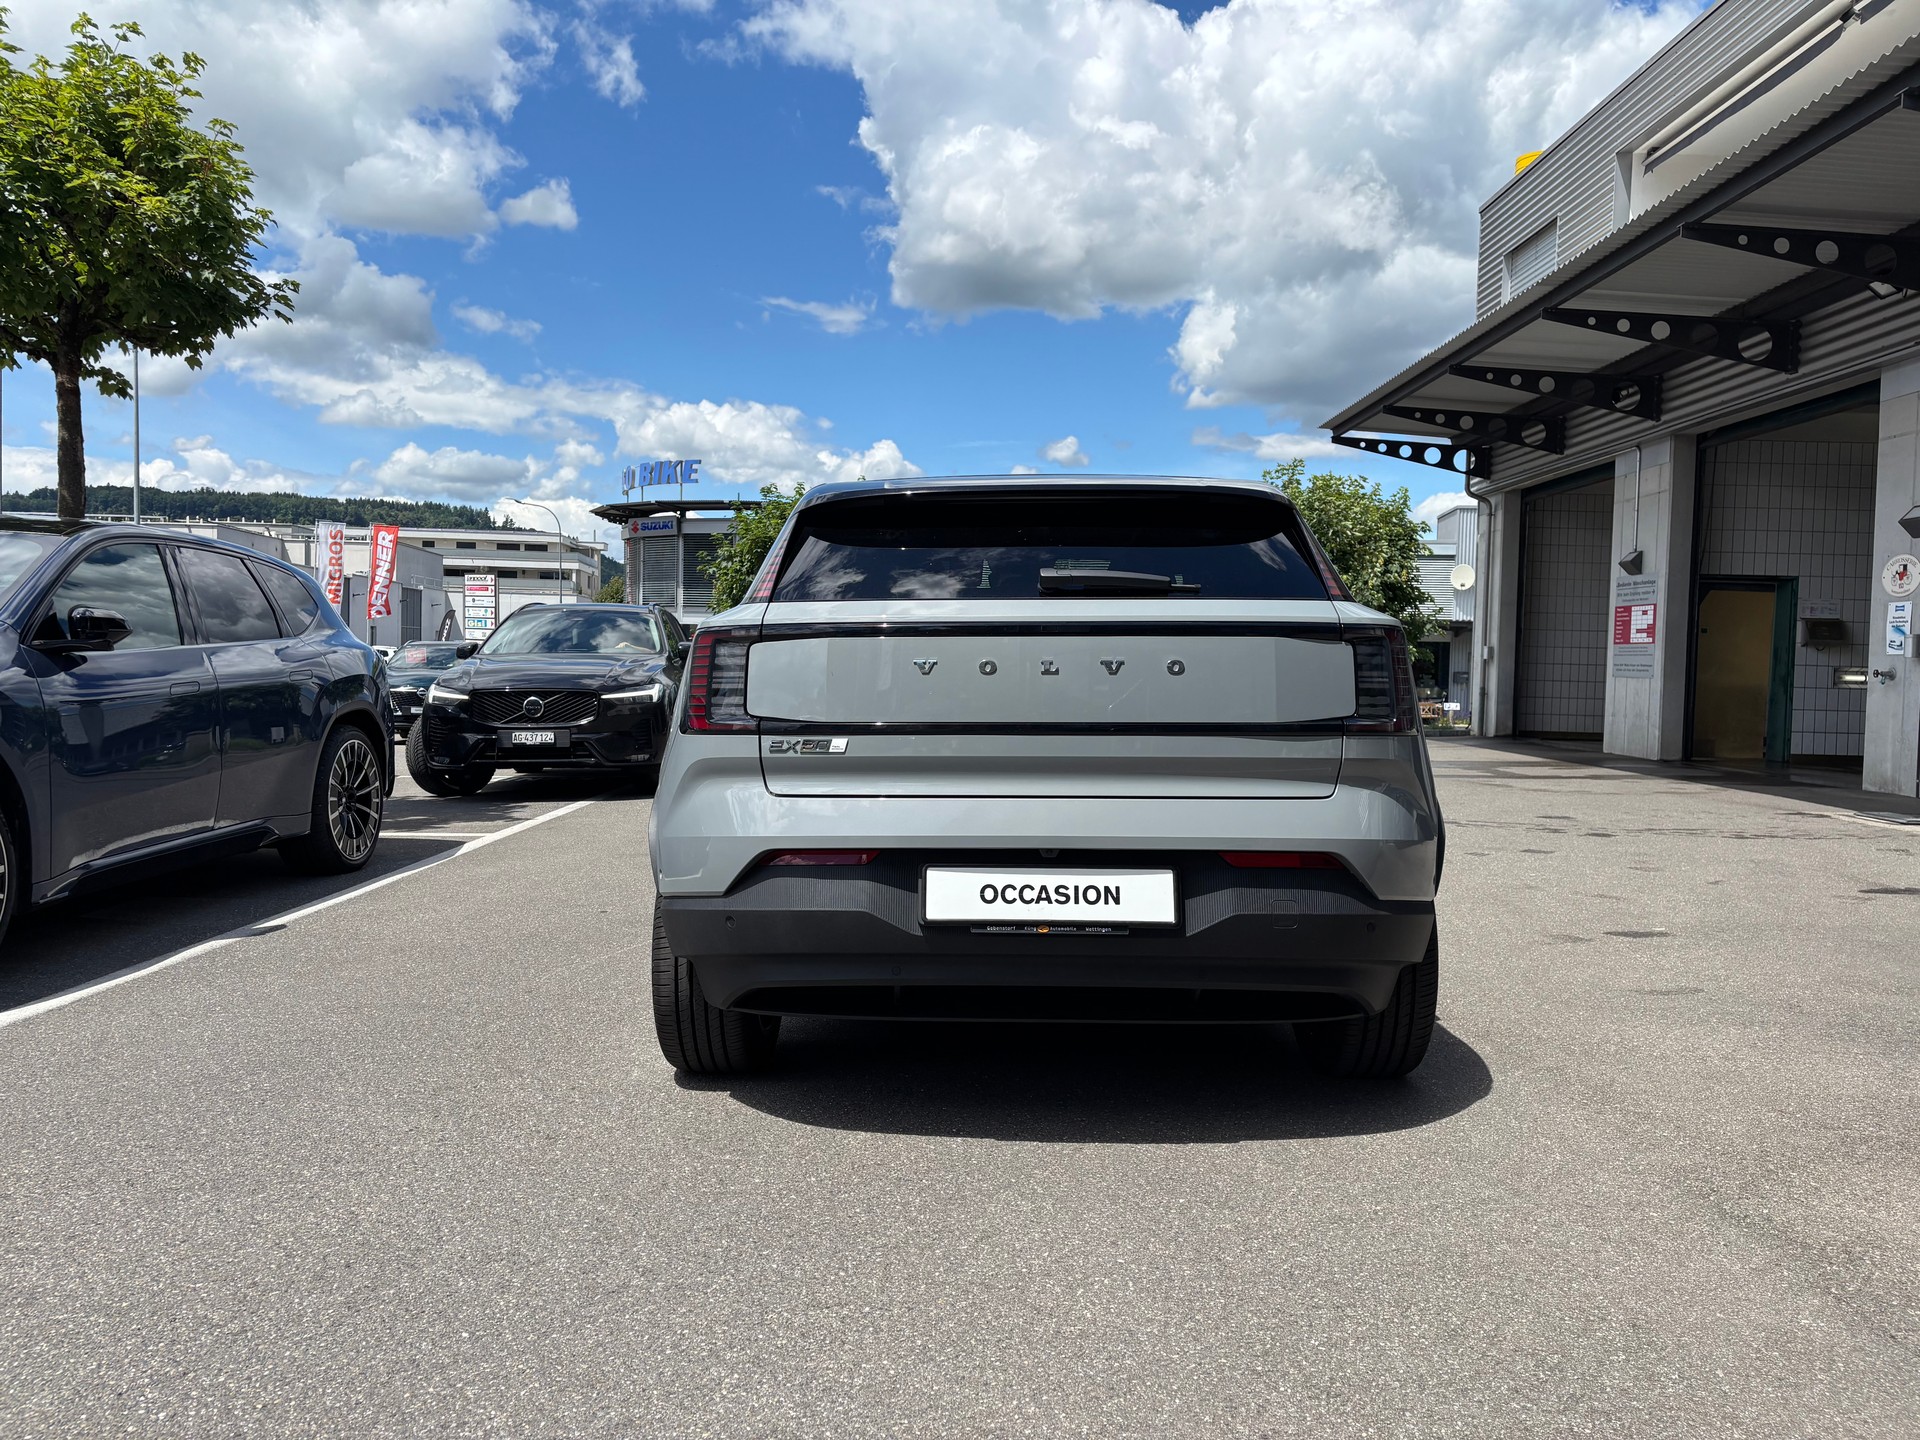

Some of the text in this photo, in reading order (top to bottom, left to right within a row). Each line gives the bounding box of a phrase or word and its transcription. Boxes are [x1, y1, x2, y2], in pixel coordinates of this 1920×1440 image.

[639, 459, 702, 487] BIKE
[640, 520, 673, 531] SUZUKI
[327, 529, 344, 605] MIGROS
[370, 530, 395, 618] DENNER
[912, 659, 1186, 676] VOLVO
[979, 884, 1121, 906] OCCASION
